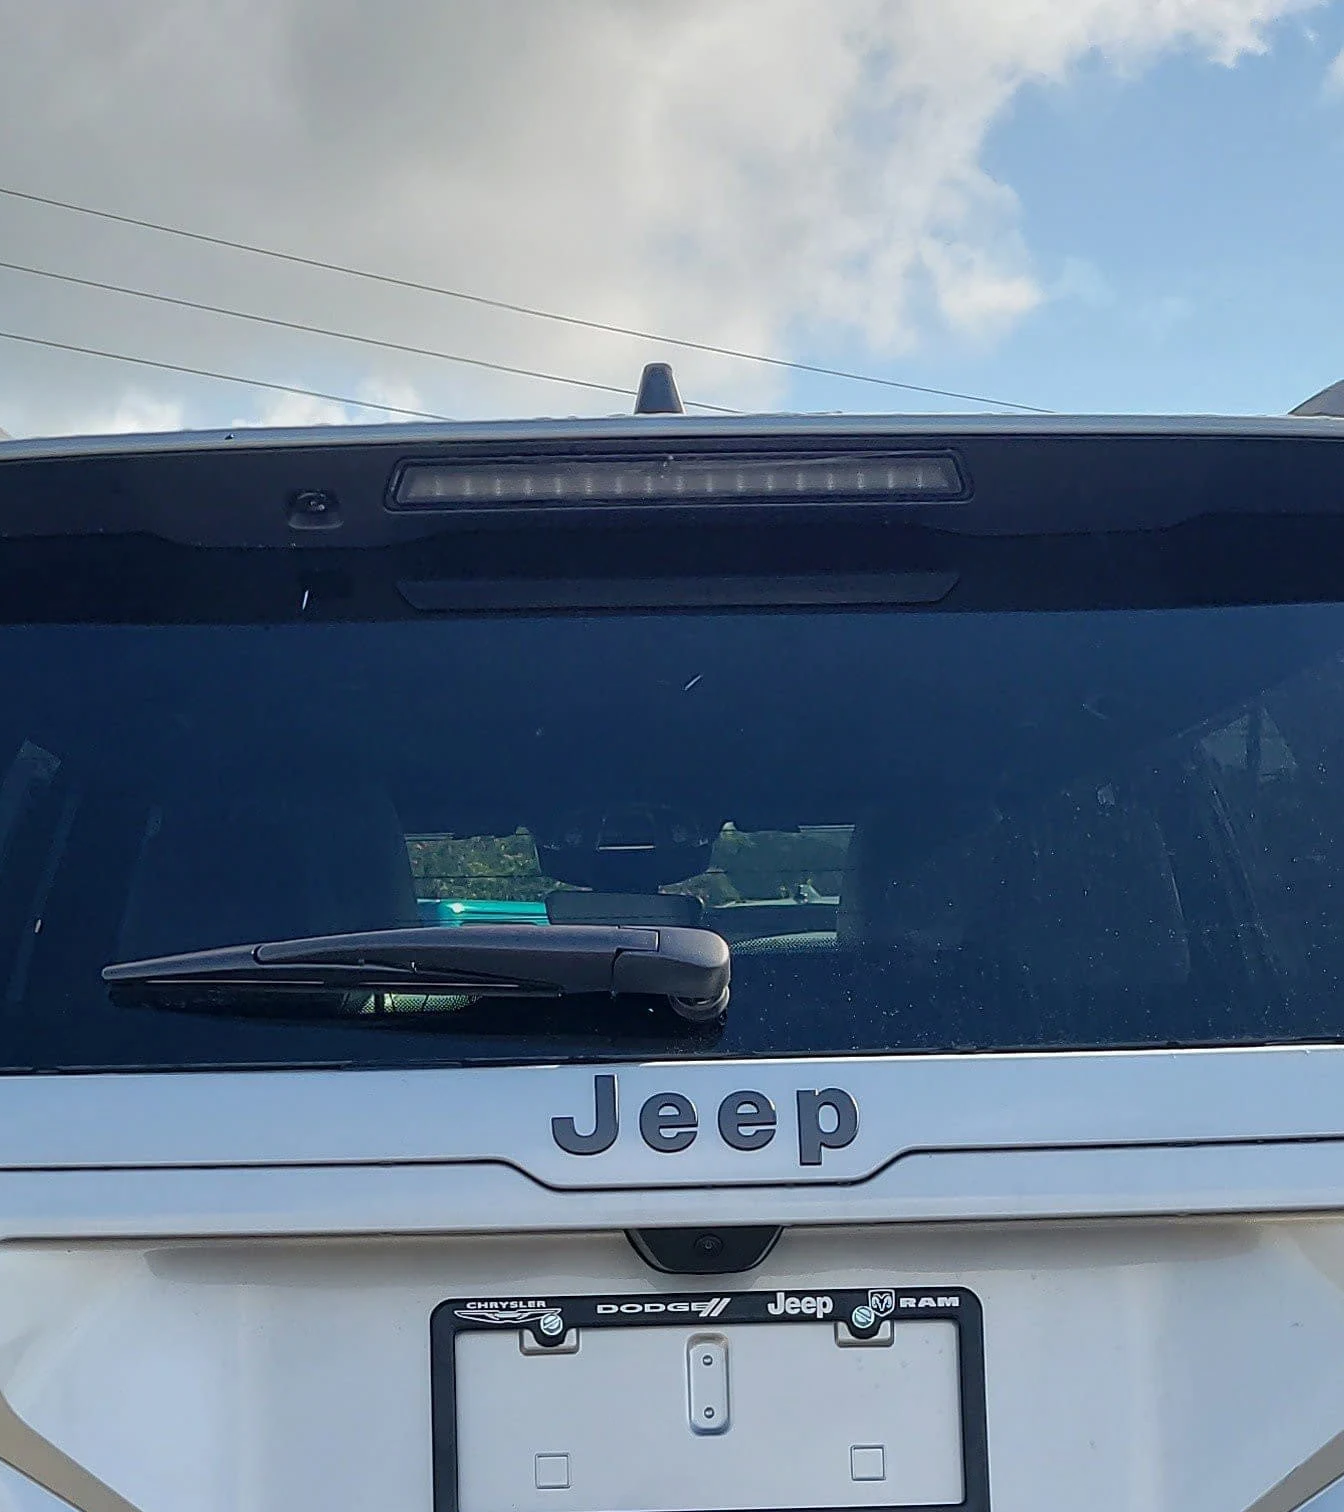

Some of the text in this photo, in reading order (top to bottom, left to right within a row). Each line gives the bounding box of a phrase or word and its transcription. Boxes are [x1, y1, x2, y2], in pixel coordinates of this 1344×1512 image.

[551, 1073, 860, 1167] Jeep
[466, 1292, 960, 1319] CHRYSLER DODGE Jeep RAM
